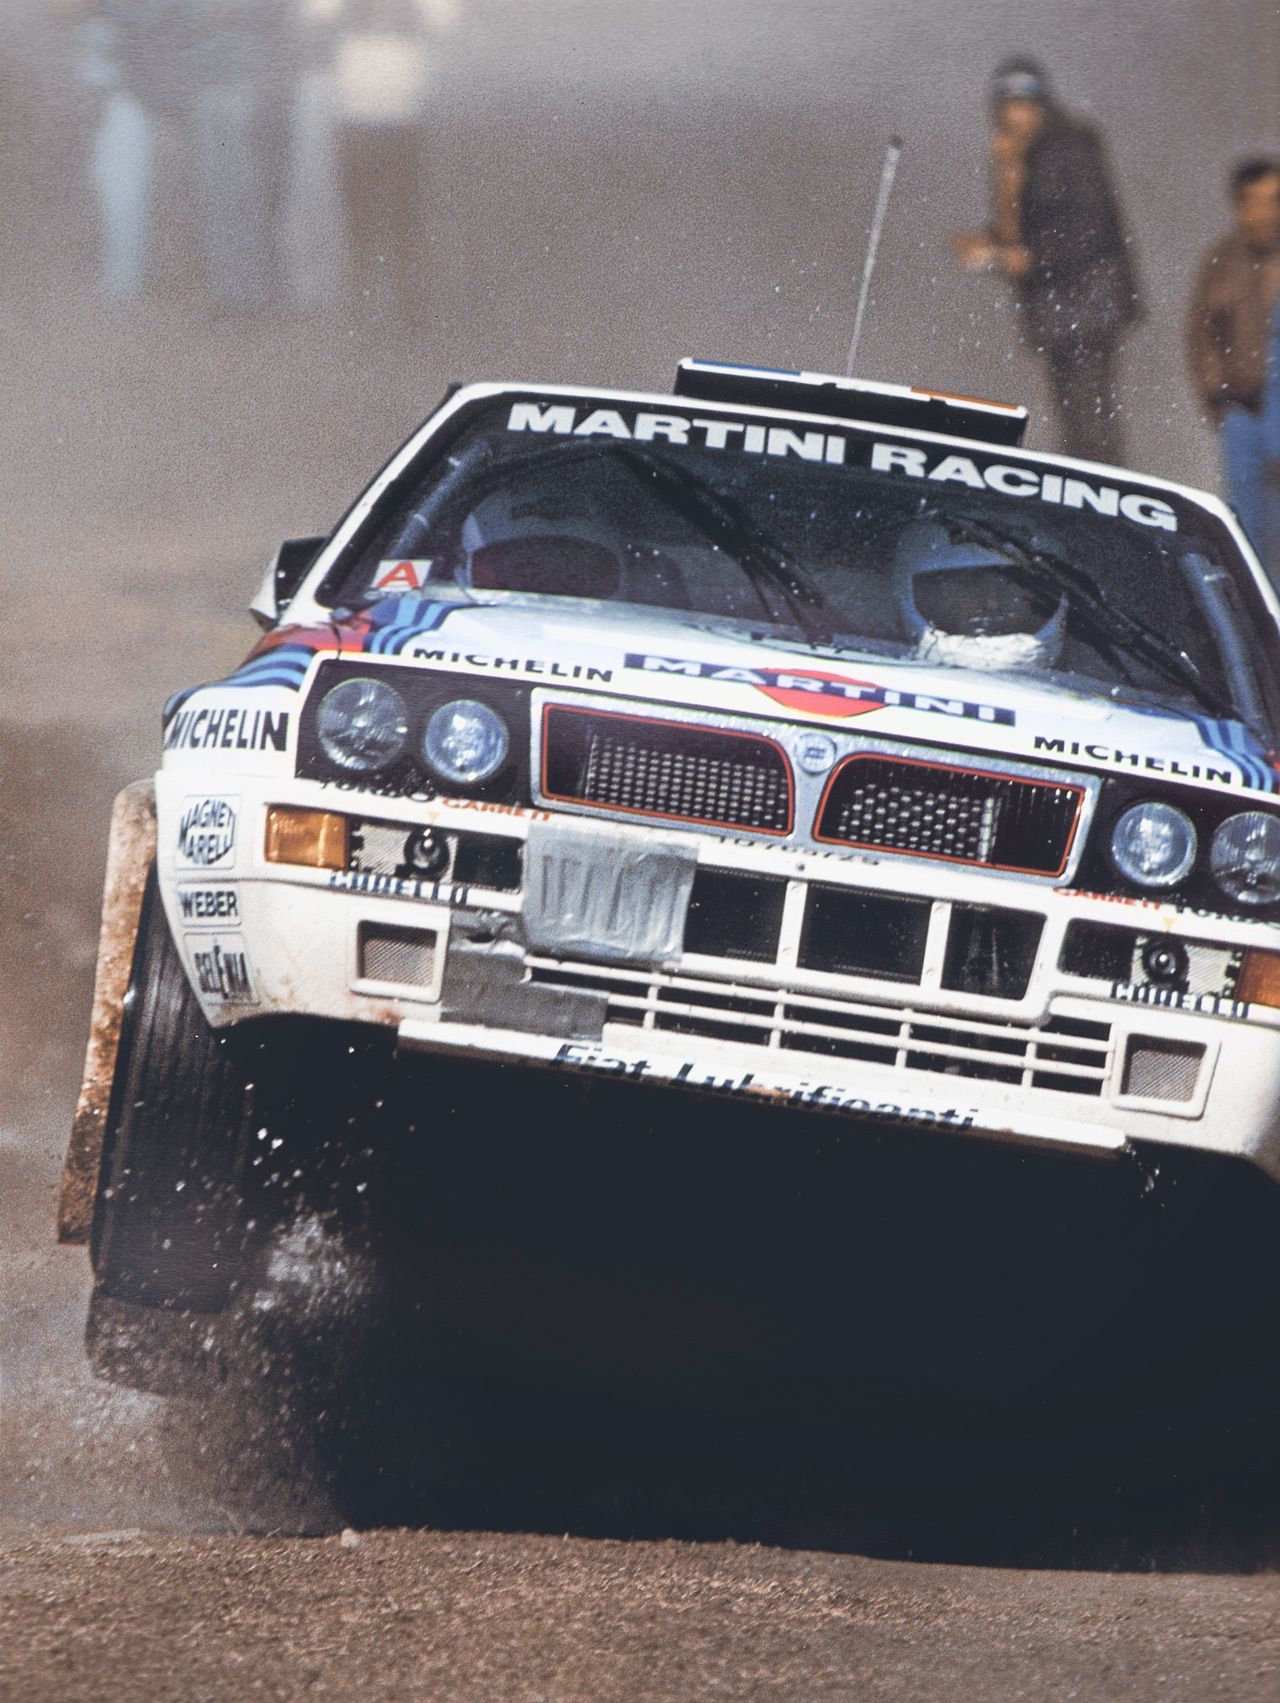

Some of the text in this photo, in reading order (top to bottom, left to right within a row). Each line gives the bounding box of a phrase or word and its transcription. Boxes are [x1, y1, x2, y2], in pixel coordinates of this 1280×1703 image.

[508, 403, 1178, 531] MARTINI RACING
[377, 561, 419, 588] A
[413, 648, 614, 683] MICHELIN
[642, 656, 996, 722] MARTINI
[165, 710, 289, 752] MICHELIN
[1034, 736, 1232, 784] MICHELIN
[179, 891, 238, 918] WEBER
